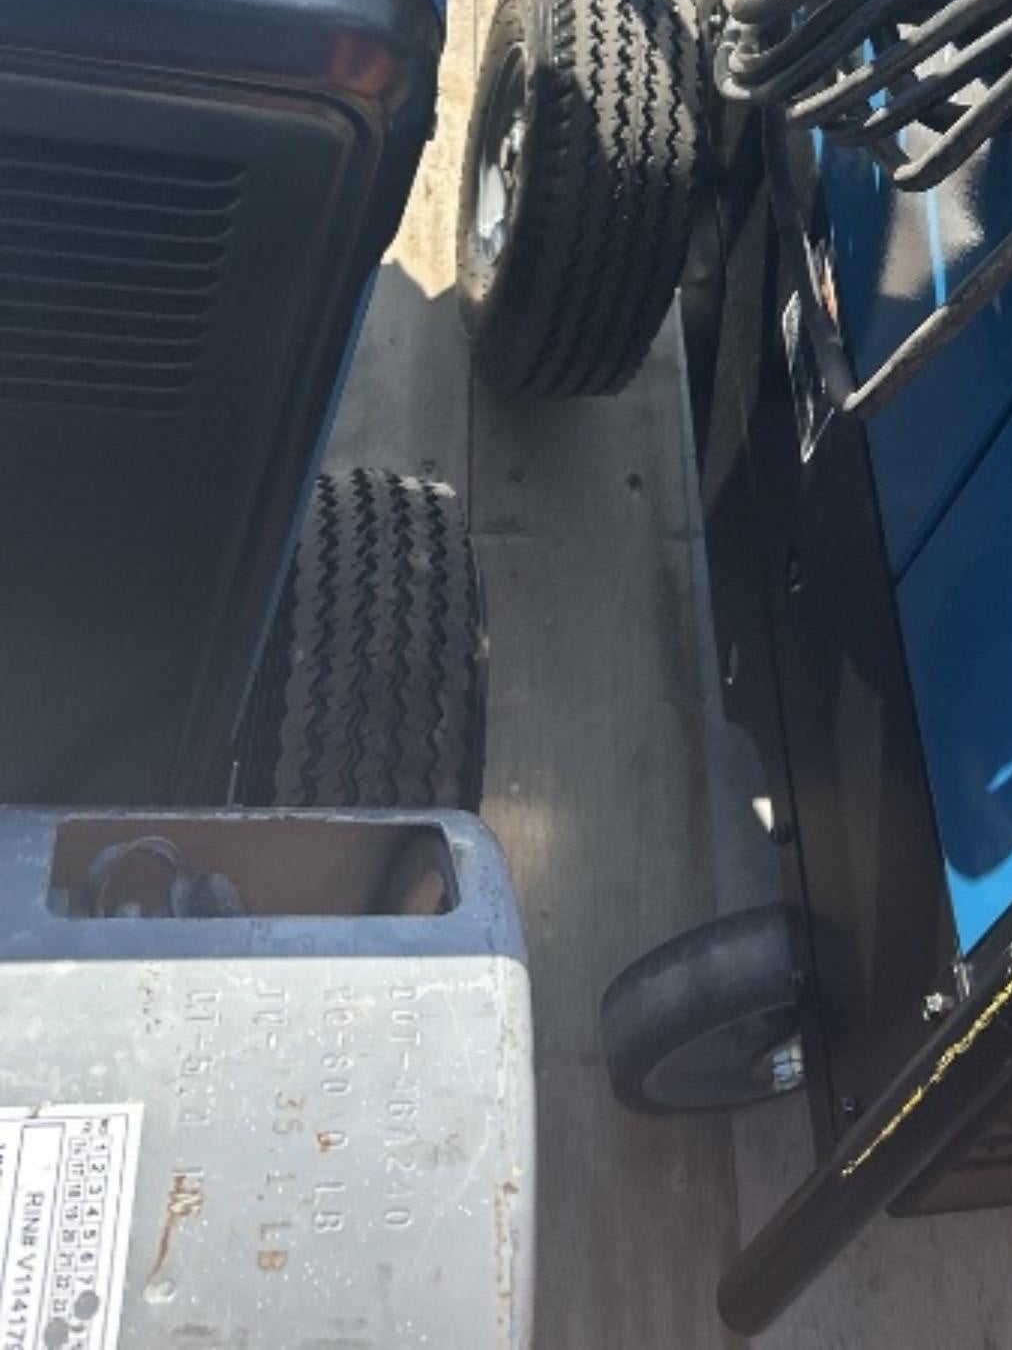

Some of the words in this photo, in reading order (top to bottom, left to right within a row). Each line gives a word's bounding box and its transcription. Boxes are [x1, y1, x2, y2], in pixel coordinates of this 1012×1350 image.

[91, 1163, 105, 1173] 2
[88, 1184, 102, 1195] 3
[86, 1206, 100, 1217] 4
[83, 1229, 97, 1240] 5
